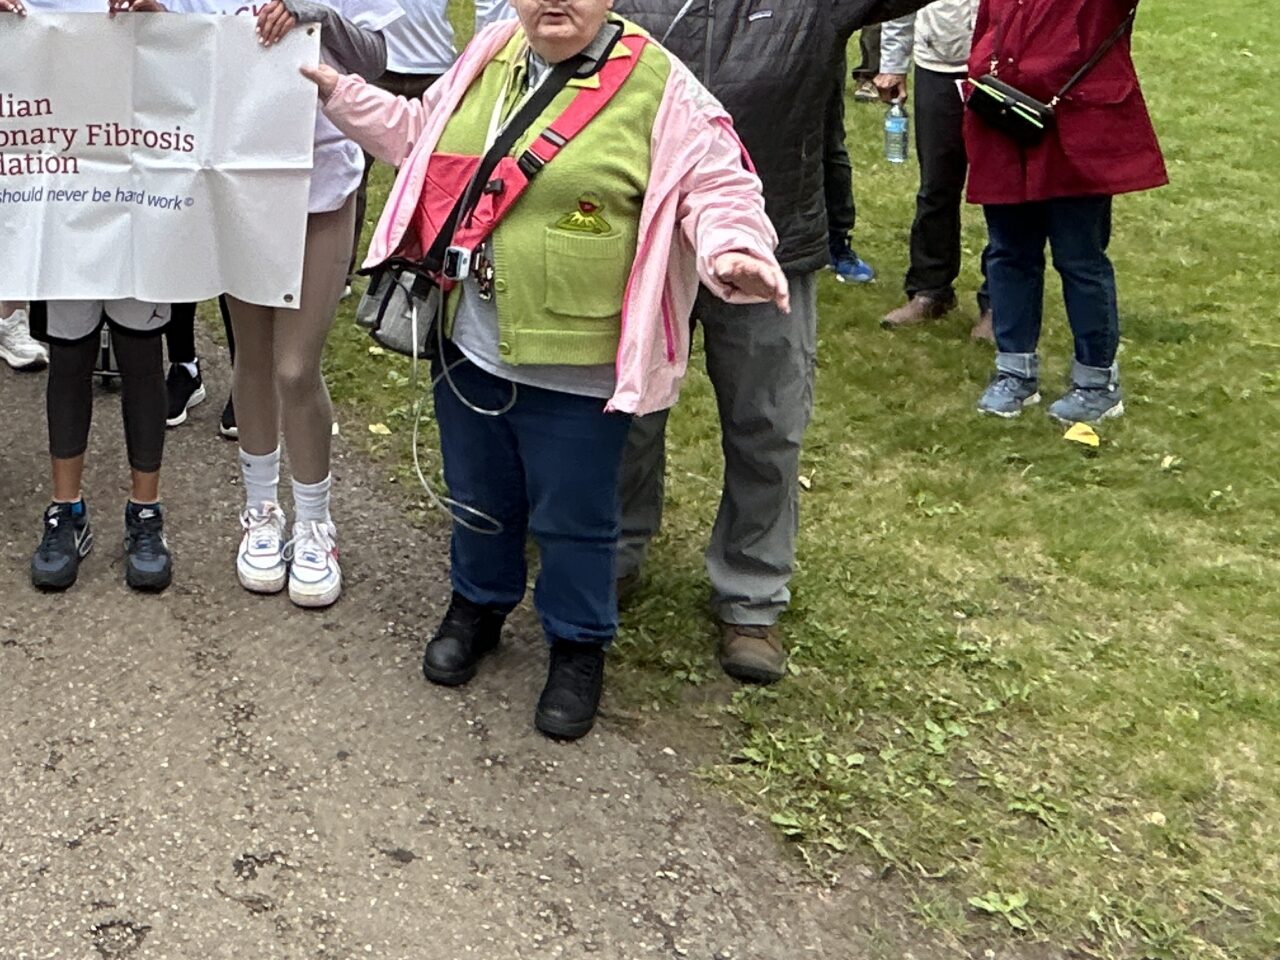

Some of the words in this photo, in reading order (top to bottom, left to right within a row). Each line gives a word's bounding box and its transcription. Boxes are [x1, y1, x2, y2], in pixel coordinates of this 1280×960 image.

[85, 123, 195, 152] Fibrosis
[47, 189, 88, 203] never
[92, 187, 112, 203] be
[115, 187, 145, 205] hard
